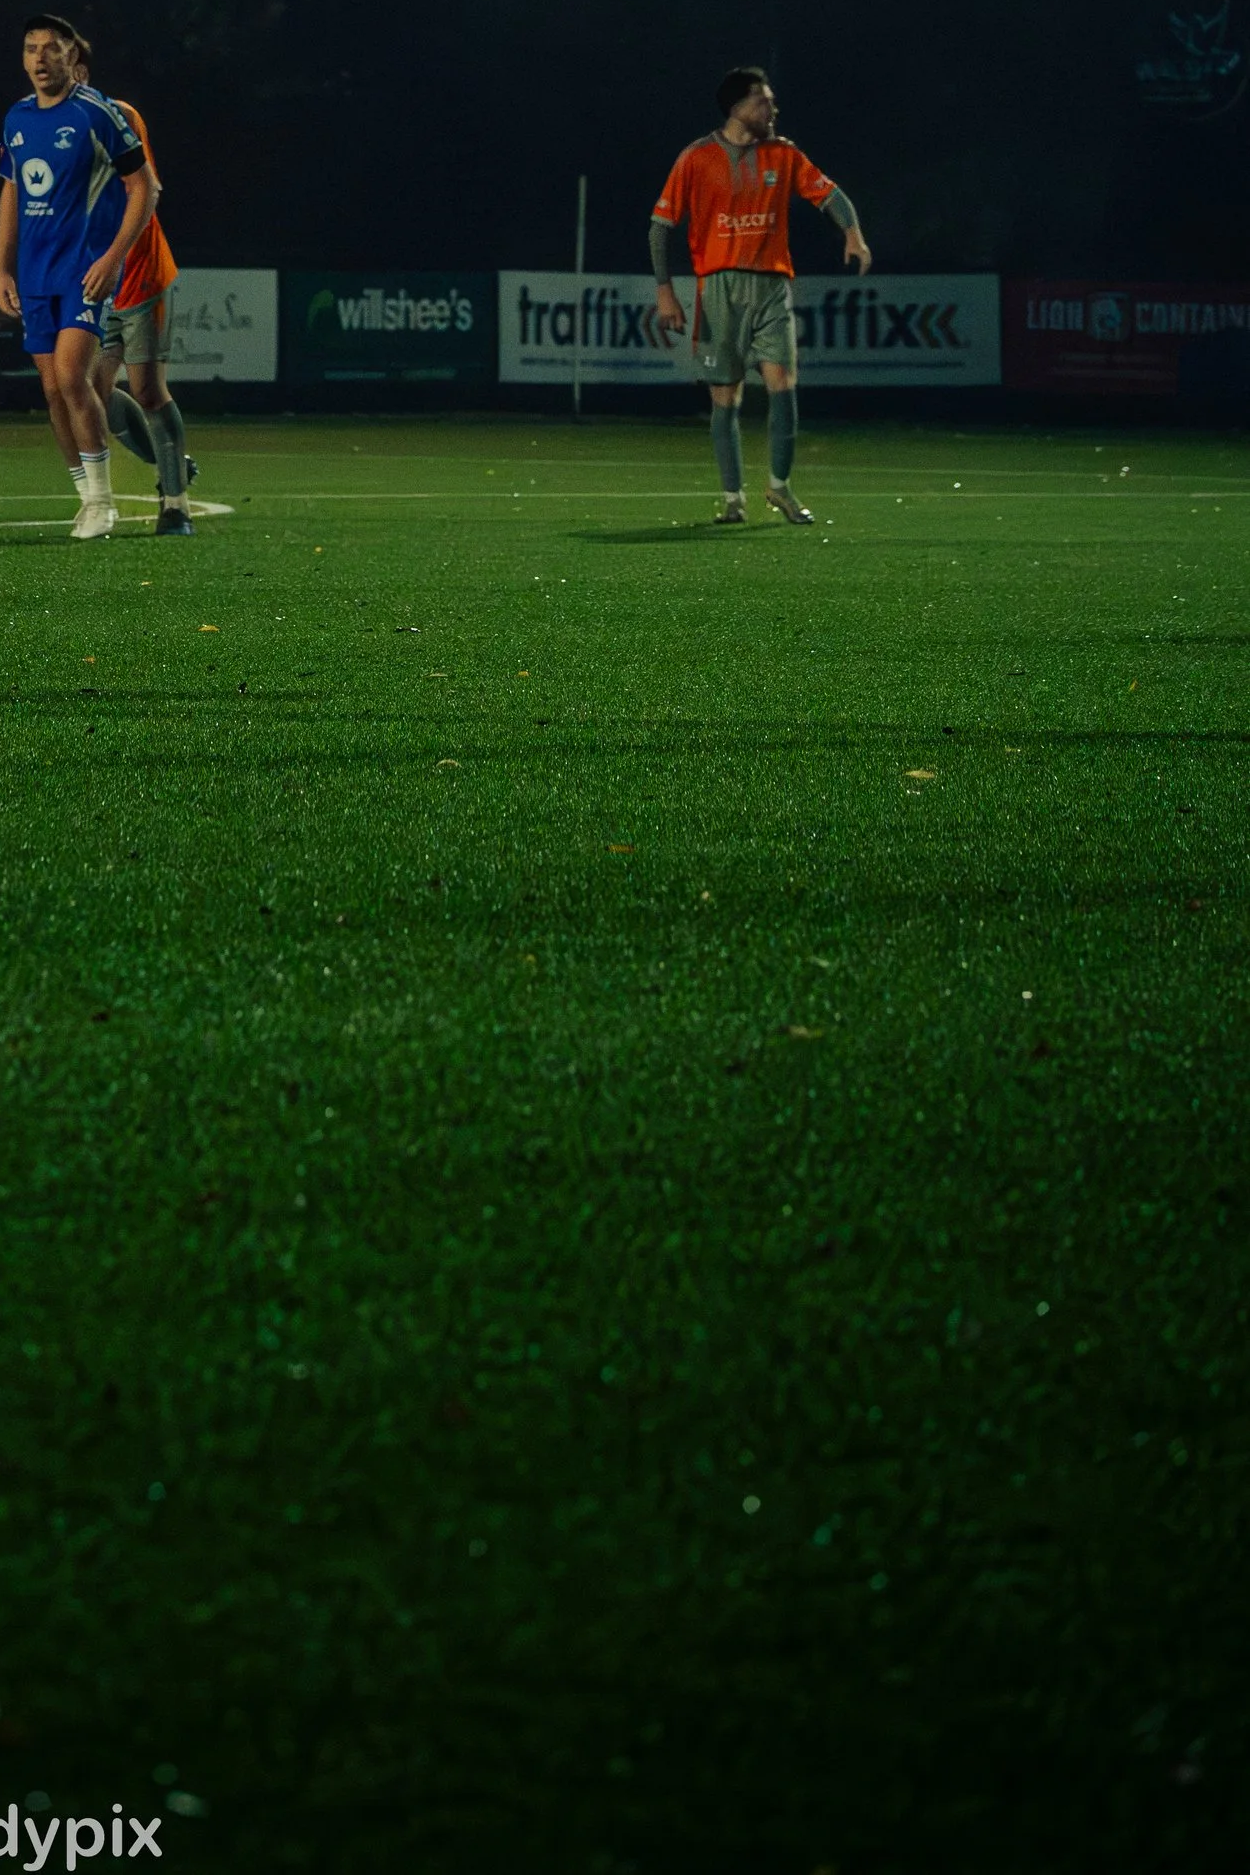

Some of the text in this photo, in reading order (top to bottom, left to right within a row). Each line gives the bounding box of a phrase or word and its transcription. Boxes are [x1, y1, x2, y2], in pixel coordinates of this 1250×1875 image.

[337, 288, 474, 332] willshee's
[519, 285, 645, 348] traffix
[793, 289, 920, 348] affix
[1027, 299, 1084, 331] LION
[1135, 301, 1250, 336] CONTAIN
